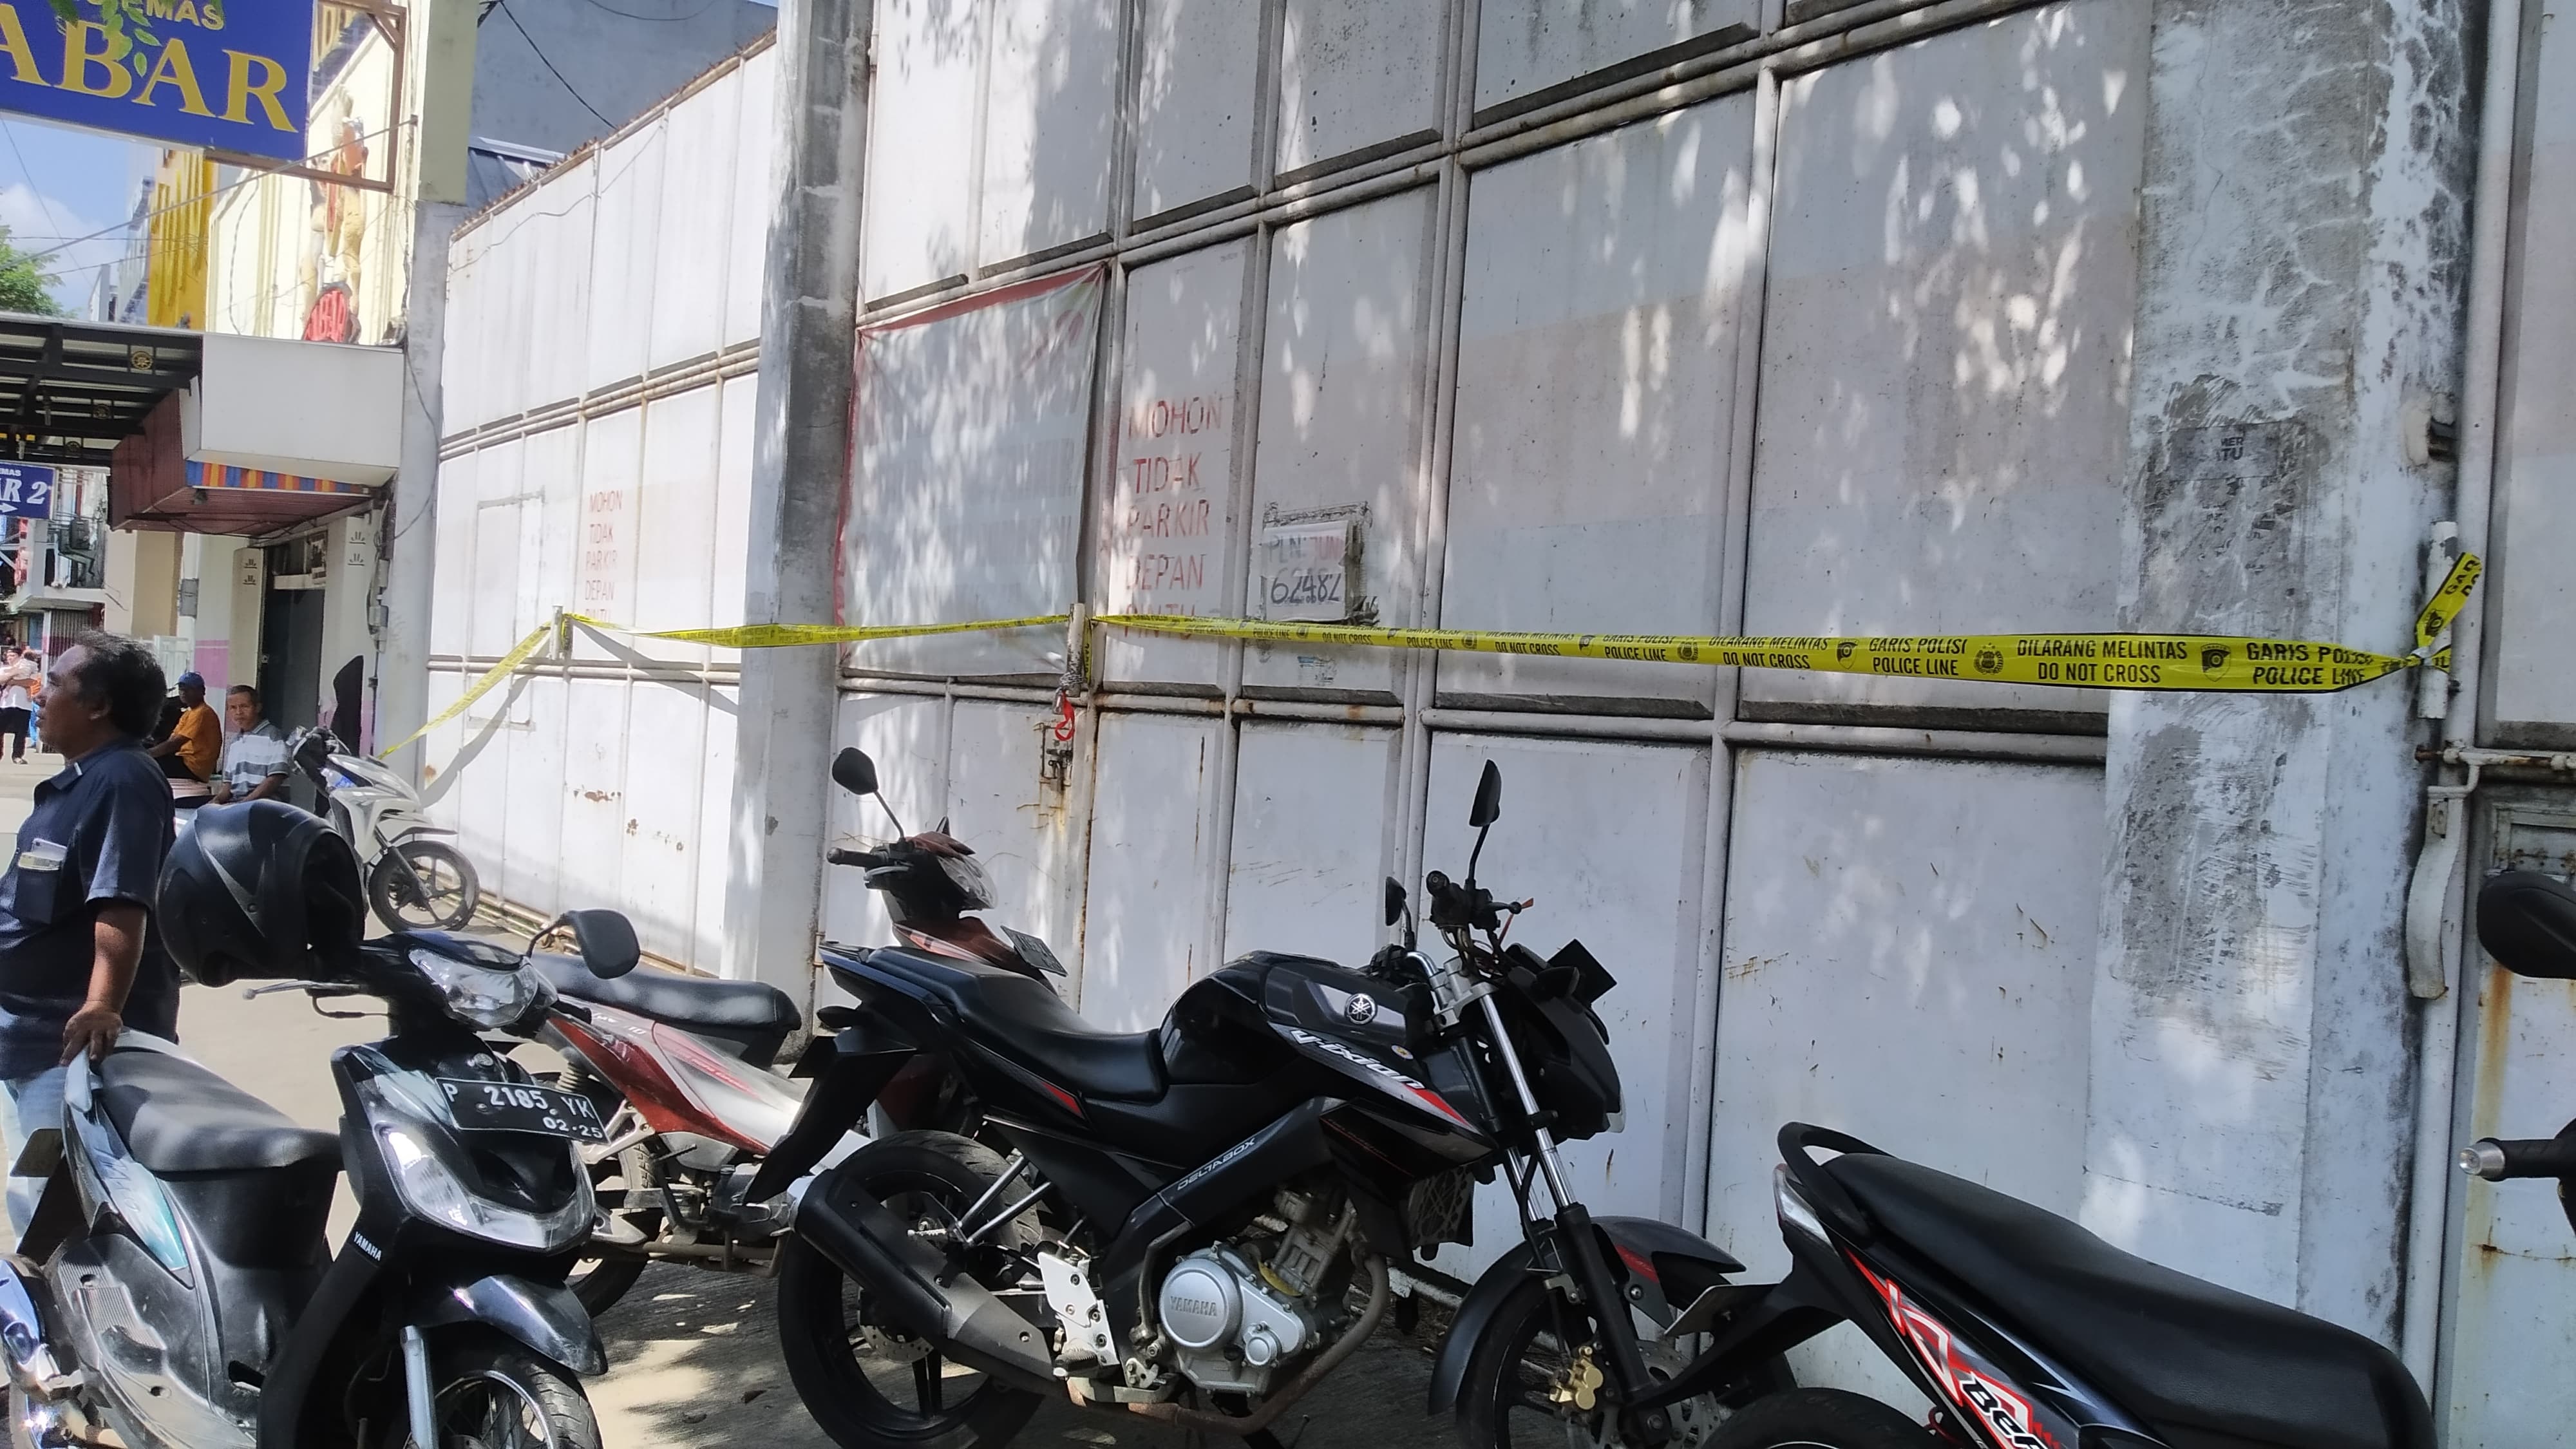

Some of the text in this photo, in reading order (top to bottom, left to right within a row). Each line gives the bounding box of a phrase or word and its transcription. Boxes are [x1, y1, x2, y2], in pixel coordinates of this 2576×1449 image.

[1128, 393, 1222, 440] MOHON
[1133, 452, 1202, 494] TIDAK
[0, 478, 48, 504] R 2
[589, 489, 623, 513] MOHON
[1127, 498, 1210, 538] PARKIR
[1126, 554, 1206, 591] DEPAN
[1406, 636, 1454, 650] POLICE LINE
[1495, 641, 1562, 656] DO NOT CROSS
[1604, 646, 1669, 661] POLICE LINE
[1709, 636, 1831, 650] DILARANG MELINTAS
[1868, 638, 1967, 655] GARIS POLISI
[2018, 639, 2188, 661] DILARANG MELINTAS
[2246, 642, 2309, 661] GARIS
[1723, 652, 1811, 669] DO NOT CROSS
[1872, 656, 1959, 676] POLICE LINE
[2038, 662, 2161, 684] DO NOT CROSS
[2253, 666, 2324, 686] POLICE
[442, 1083, 595, 1119] P 2185 YK
[1177, 1137, 1255, 1191] DELTABOX
[354, 1231, 382, 1262] YAMAHA
[1170, 1295, 1218, 1317] YAMAHA
